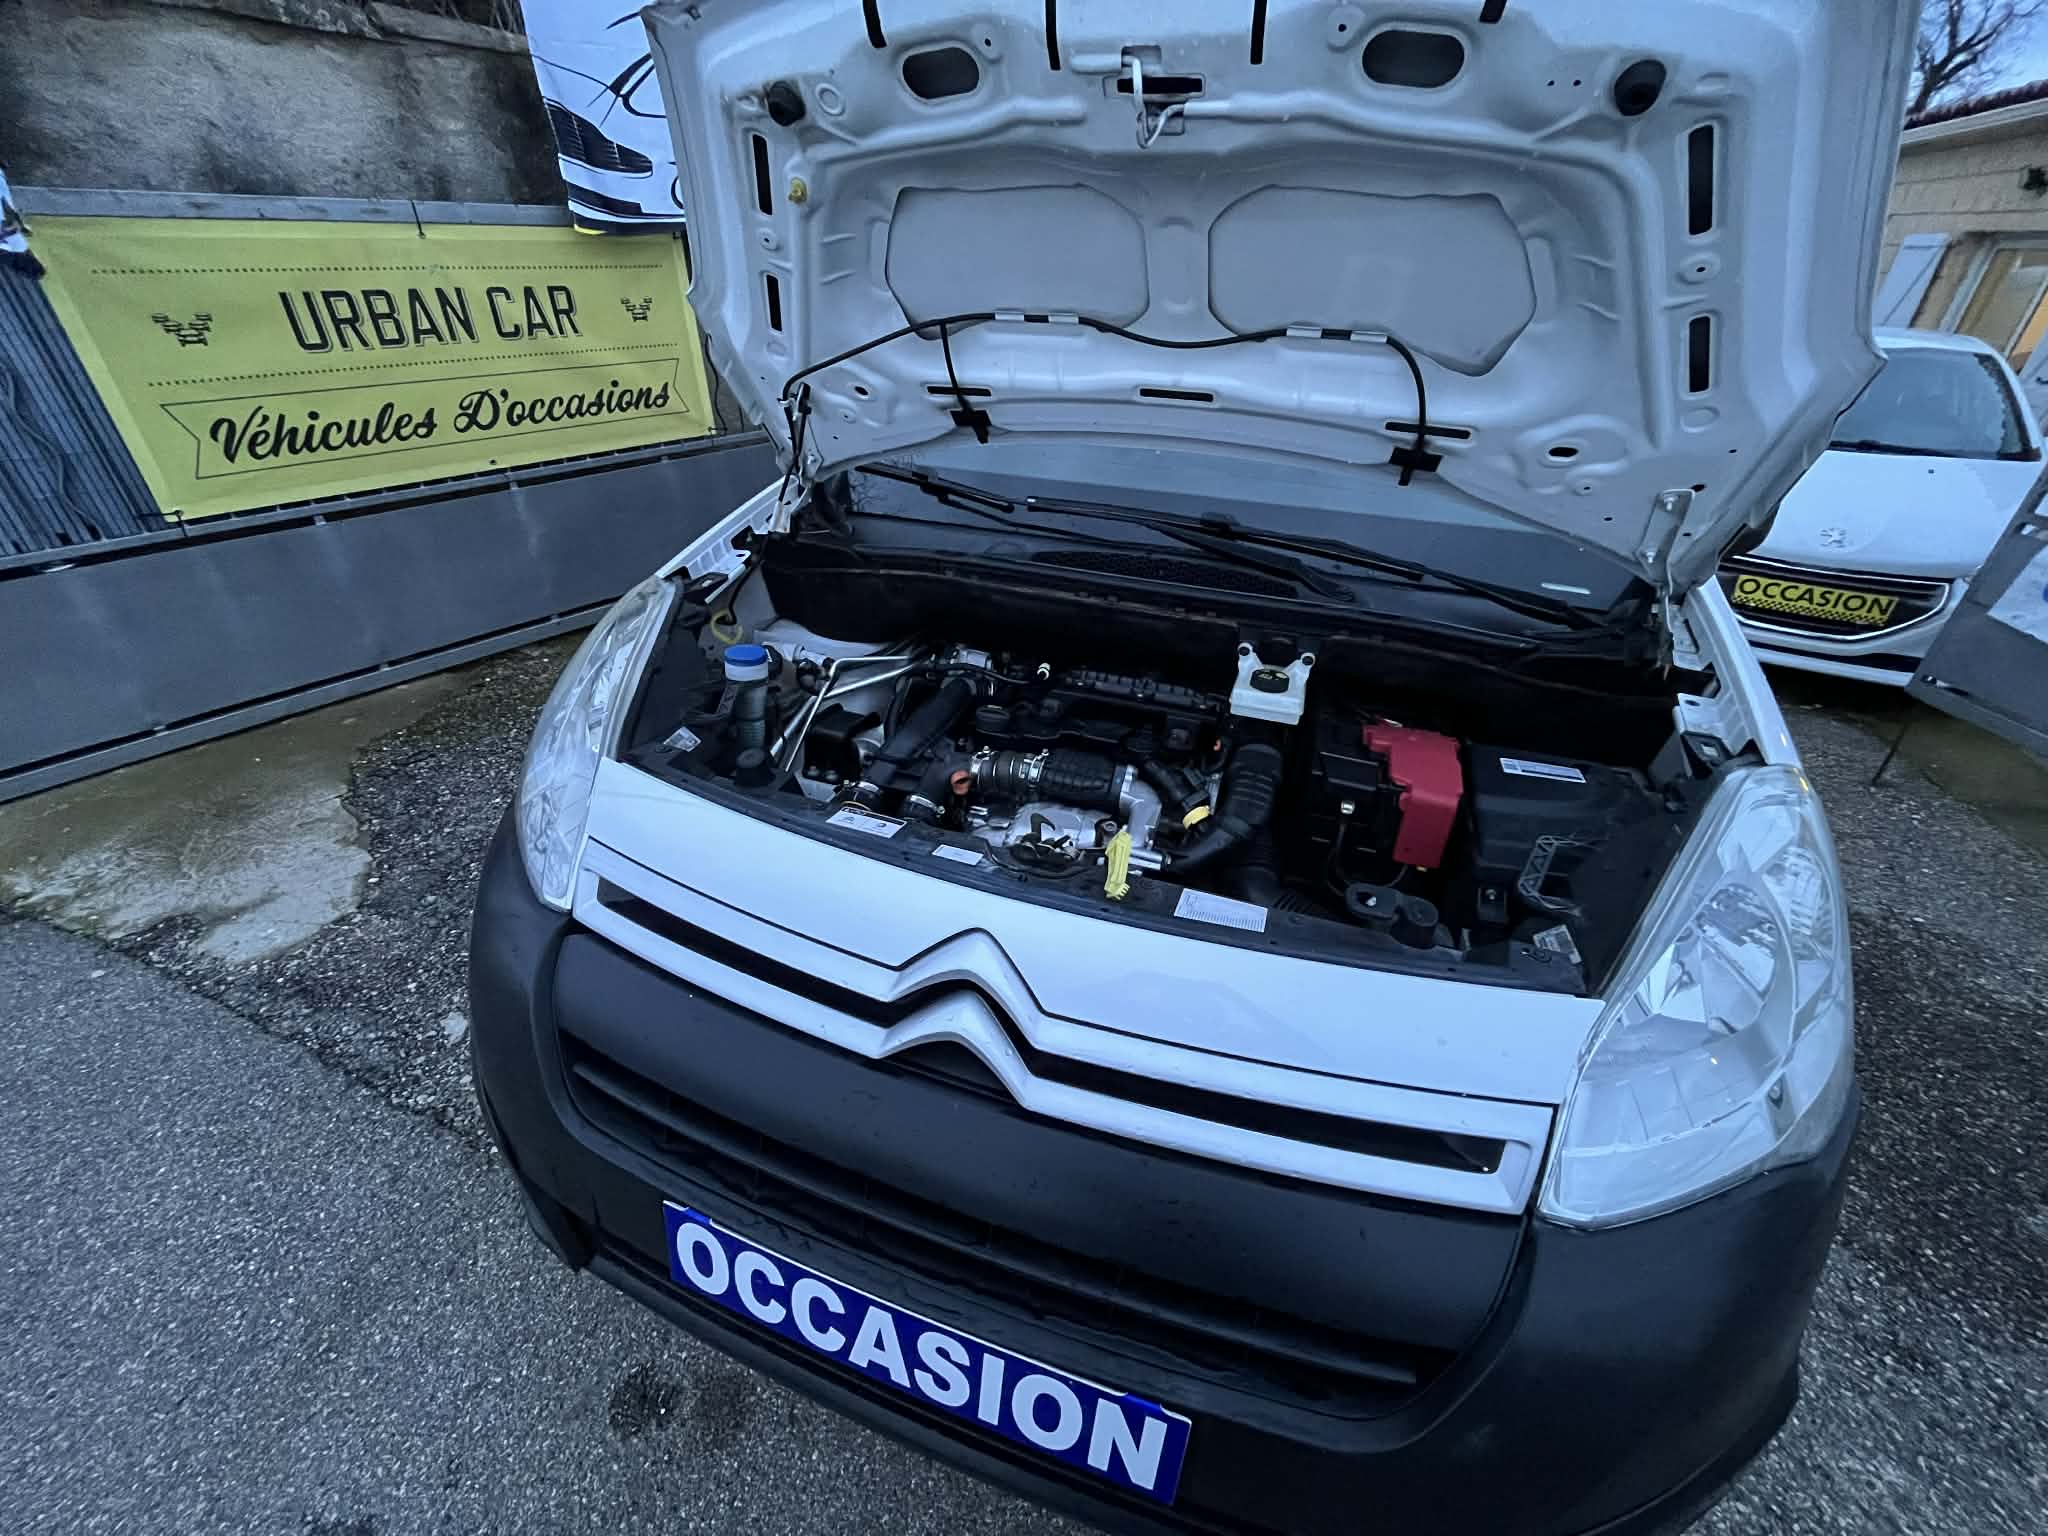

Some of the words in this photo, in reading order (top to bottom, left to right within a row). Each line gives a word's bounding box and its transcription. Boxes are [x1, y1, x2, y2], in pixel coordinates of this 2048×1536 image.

[278, 286, 481, 353] URBAN
[486, 285, 584, 341] CAR
[209, 401, 438, 464] Véhicules
[453, 379, 670, 433] D'occasions
[1739, 578, 1894, 616] OCCASION
[676, 1222, 1168, 1491] OCCASION
